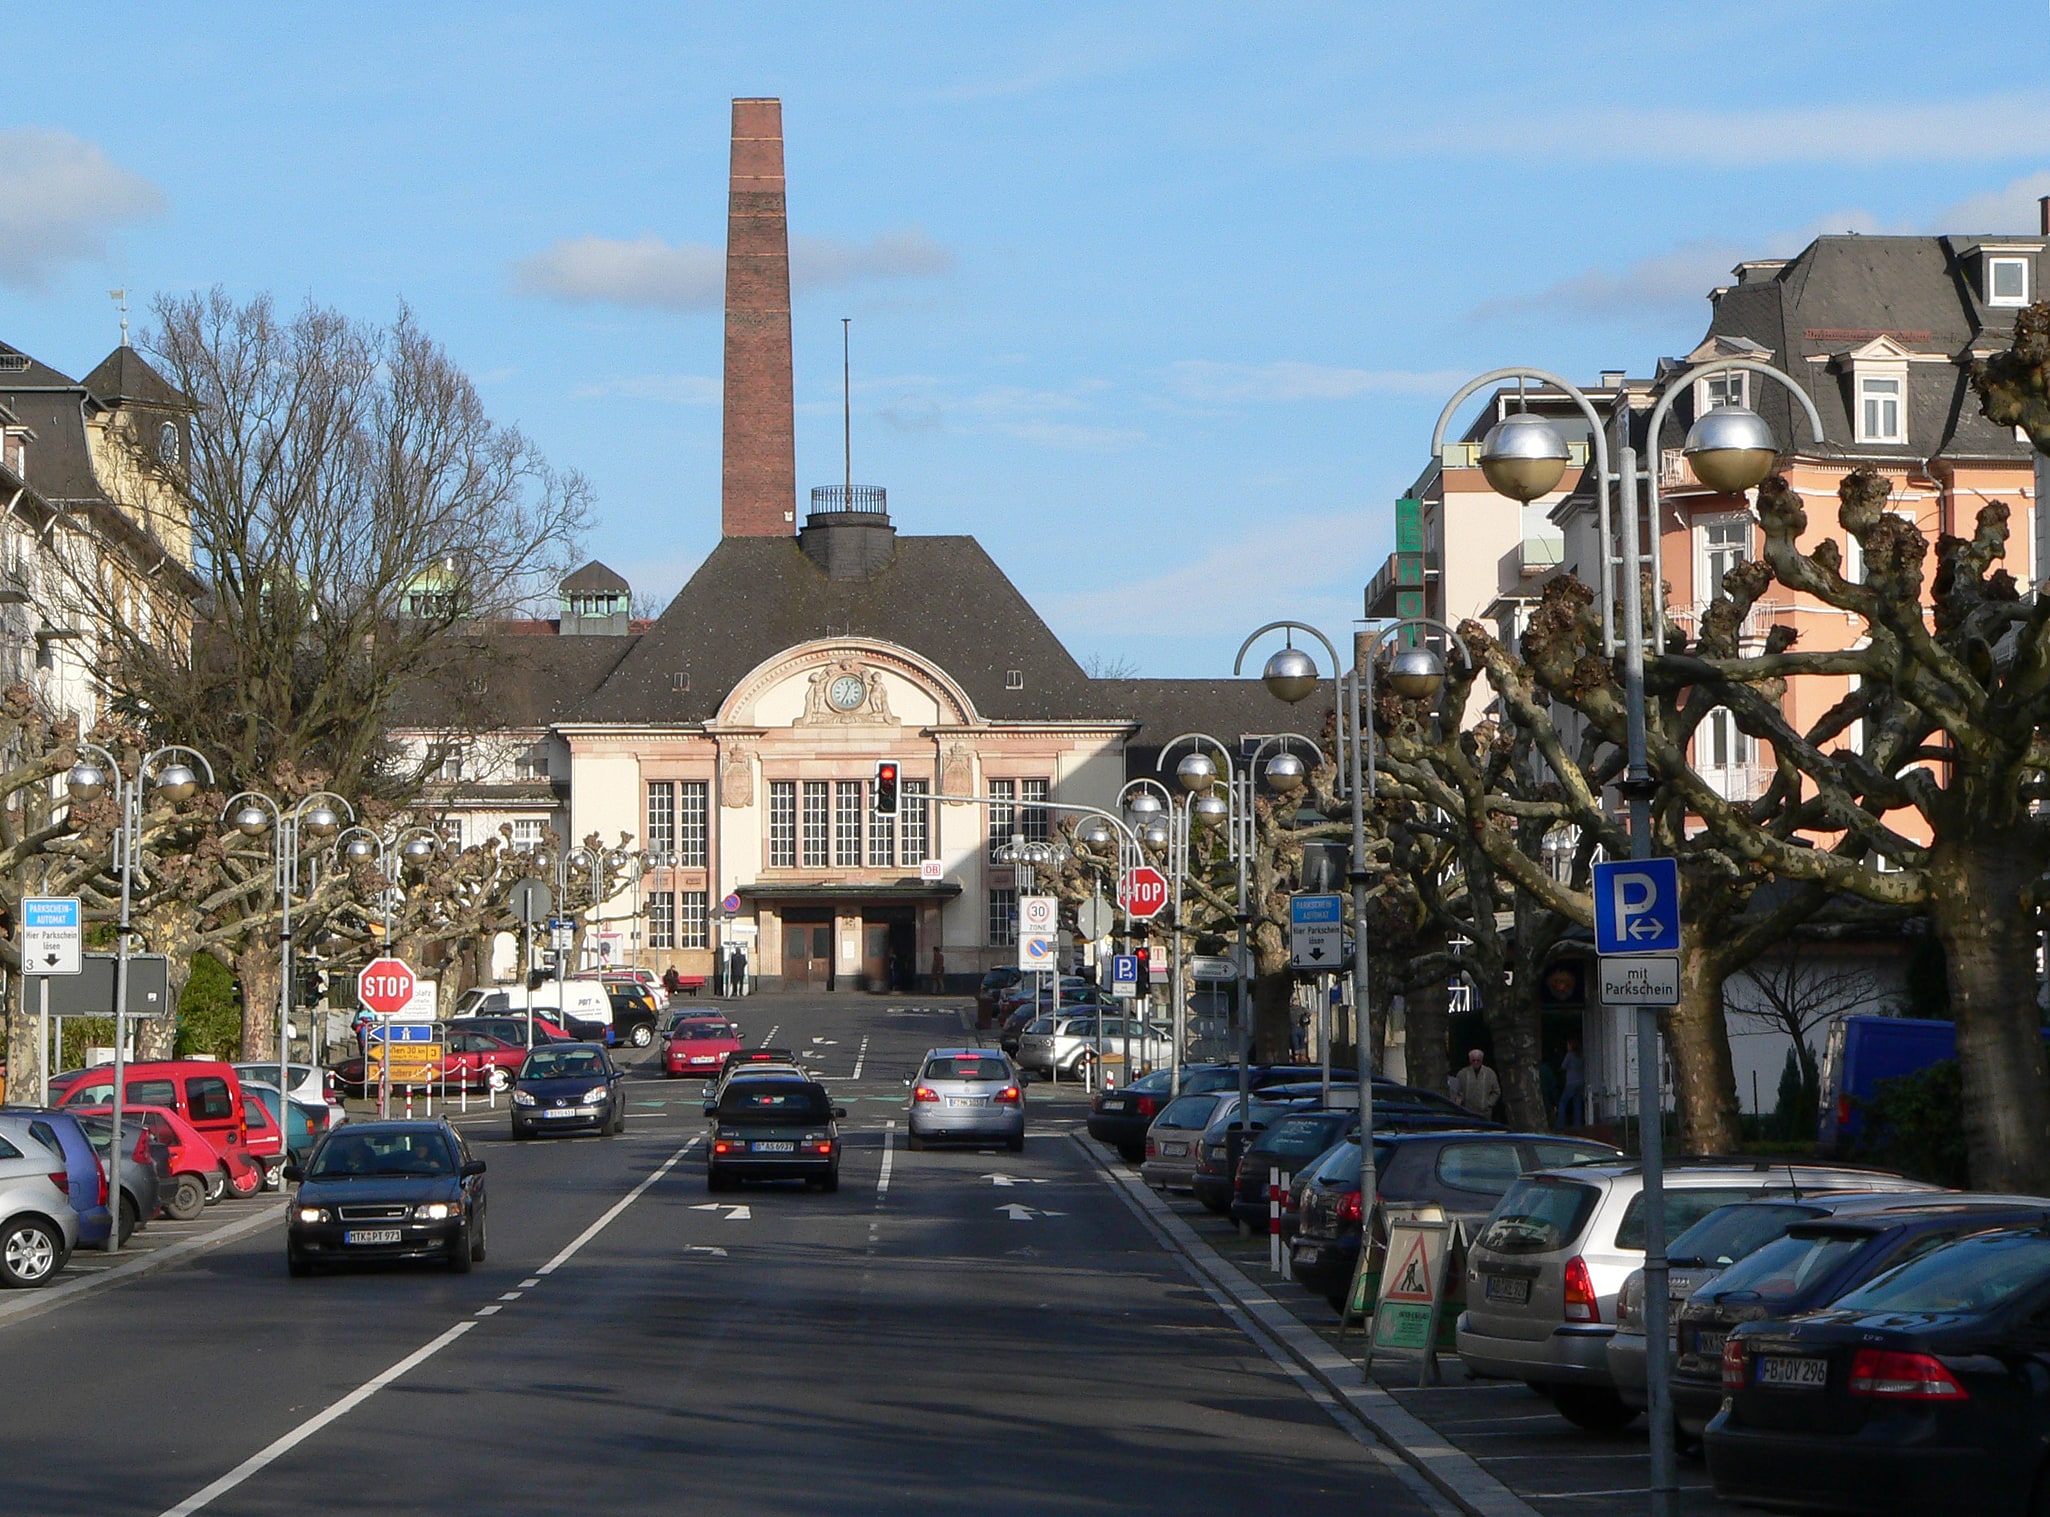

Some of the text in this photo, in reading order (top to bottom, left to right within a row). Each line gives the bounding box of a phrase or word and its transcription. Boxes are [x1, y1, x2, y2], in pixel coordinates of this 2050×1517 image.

[926, 866, 939, 874] DB
[29, 903, 73, 913] PARKSCHEIN-
[1031, 906, 1045, 917] 30
[1613, 873, 1658, 942] P
[37, 915, 67, 924] AUTOMAT
[26, 930, 77, 939] Hier Parkschein
[43, 942, 61, 950] lösen
[26, 959, 34, 970] 3
[1293, 954, 1300, 964] 4
[1119, 959, 1132, 979] P
[1628, 968, 1648, 979] mit
[365, 976, 410, 998] STOP
[1605, 982, 1673, 996] Parkschein
[407, 1046, 417, 1054] 30
[350, 1231, 400, 1242] MTK PT 971
[1763, 1360, 1779, 1380] FB
[1802, 1361, 1826, 1382] 296
